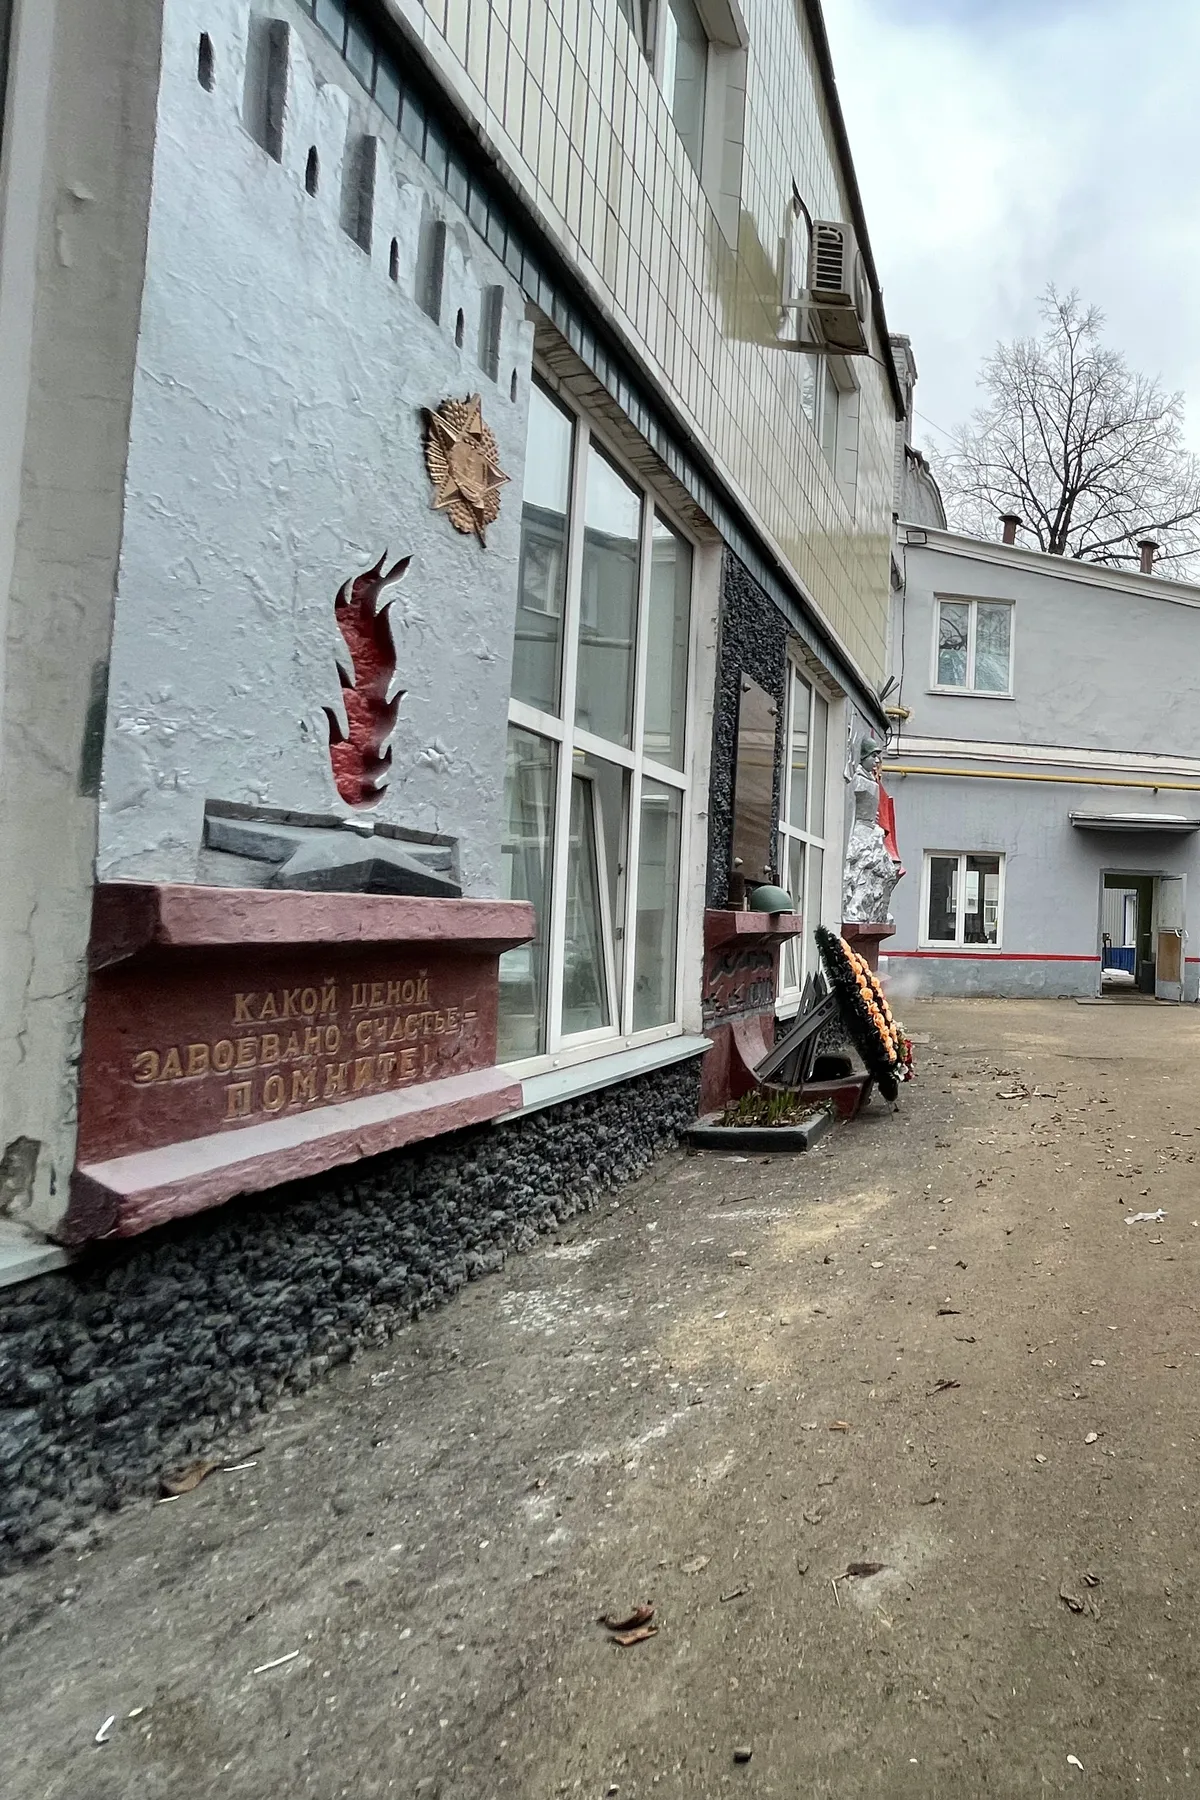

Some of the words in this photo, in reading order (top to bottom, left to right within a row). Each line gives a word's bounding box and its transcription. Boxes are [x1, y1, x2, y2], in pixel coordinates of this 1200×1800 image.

[233, 977, 339, 1022] КАКОЙ
[350, 968, 430, 1009] ЦЕНОЙ
[224, 1044, 432, 1117] ПОМНИТЕ!
